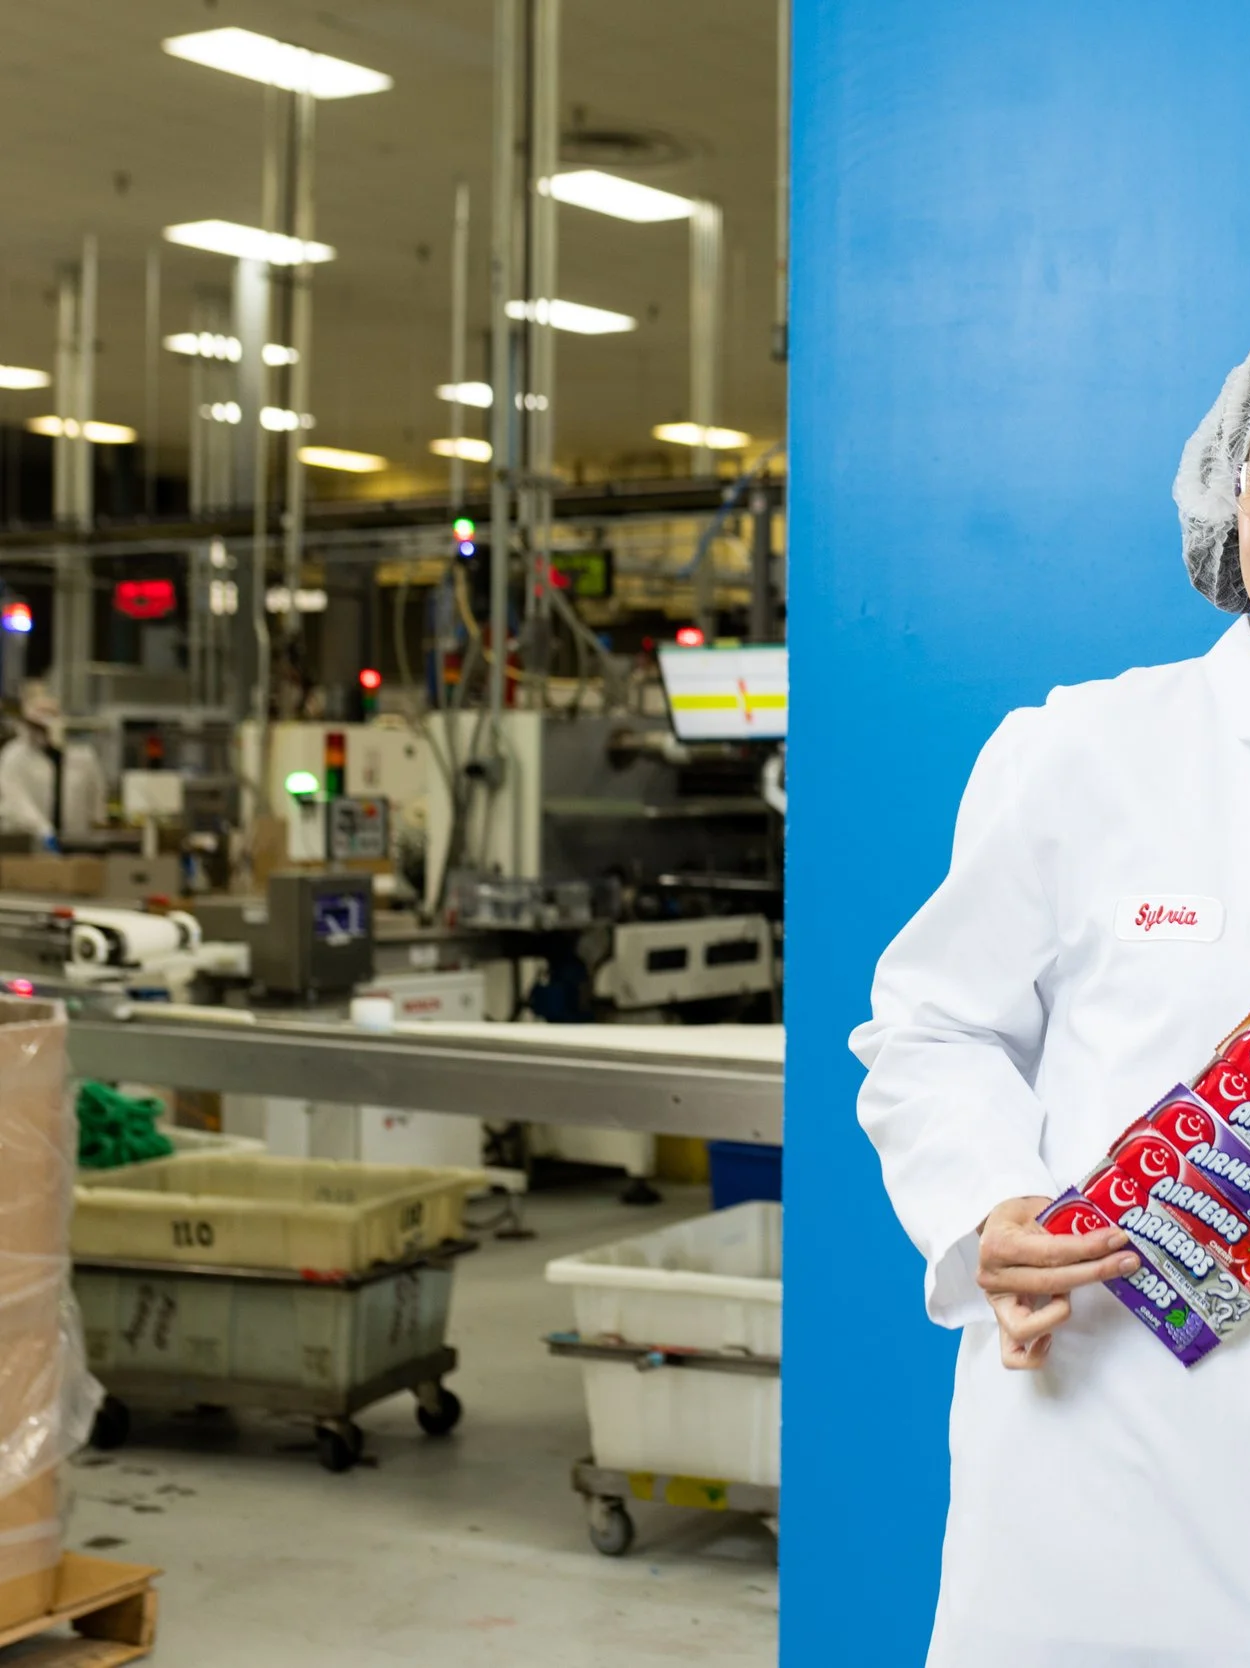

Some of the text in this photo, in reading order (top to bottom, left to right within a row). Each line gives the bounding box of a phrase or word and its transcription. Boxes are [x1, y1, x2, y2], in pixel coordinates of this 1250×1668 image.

[1135, 903, 1198, 932] Sylvia
[1149, 1175, 1248, 1242] AIRHEADS
[172, 1219, 214, 1247] 110
[1118, 1206, 1215, 1277] AIRHEADS
[1209, 1239, 1234, 1264] CHERRY
[1126, 1266, 1178, 1309] EADS
[1164, 1262, 1211, 1309] WHITE MYSTERY
[1139, 1305, 1161, 1328] GRAPE
